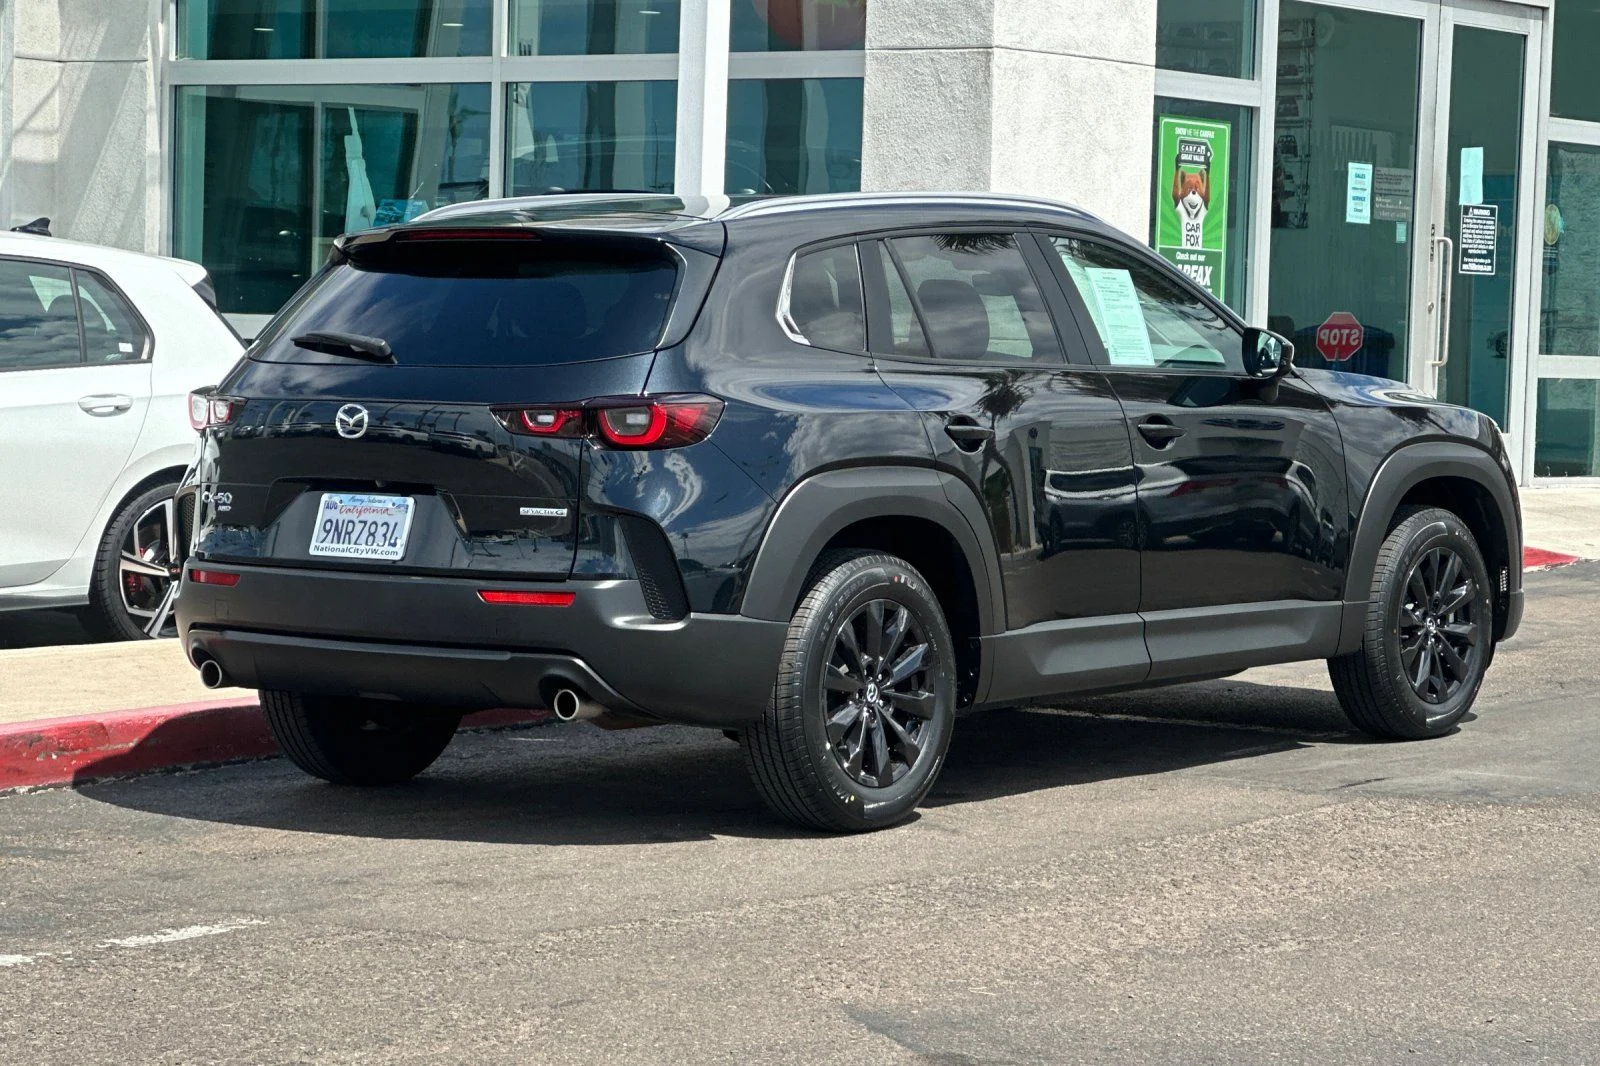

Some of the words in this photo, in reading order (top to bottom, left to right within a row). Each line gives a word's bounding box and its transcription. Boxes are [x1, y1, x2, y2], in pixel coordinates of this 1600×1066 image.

[1185, 222, 1200, 233] CAR
[1185, 234, 1200, 247] FOX
[1176, 251, 1189, 260] Check
[340, 505, 393, 518] California
[313, 544, 399, 557] NationalCityVW.com
